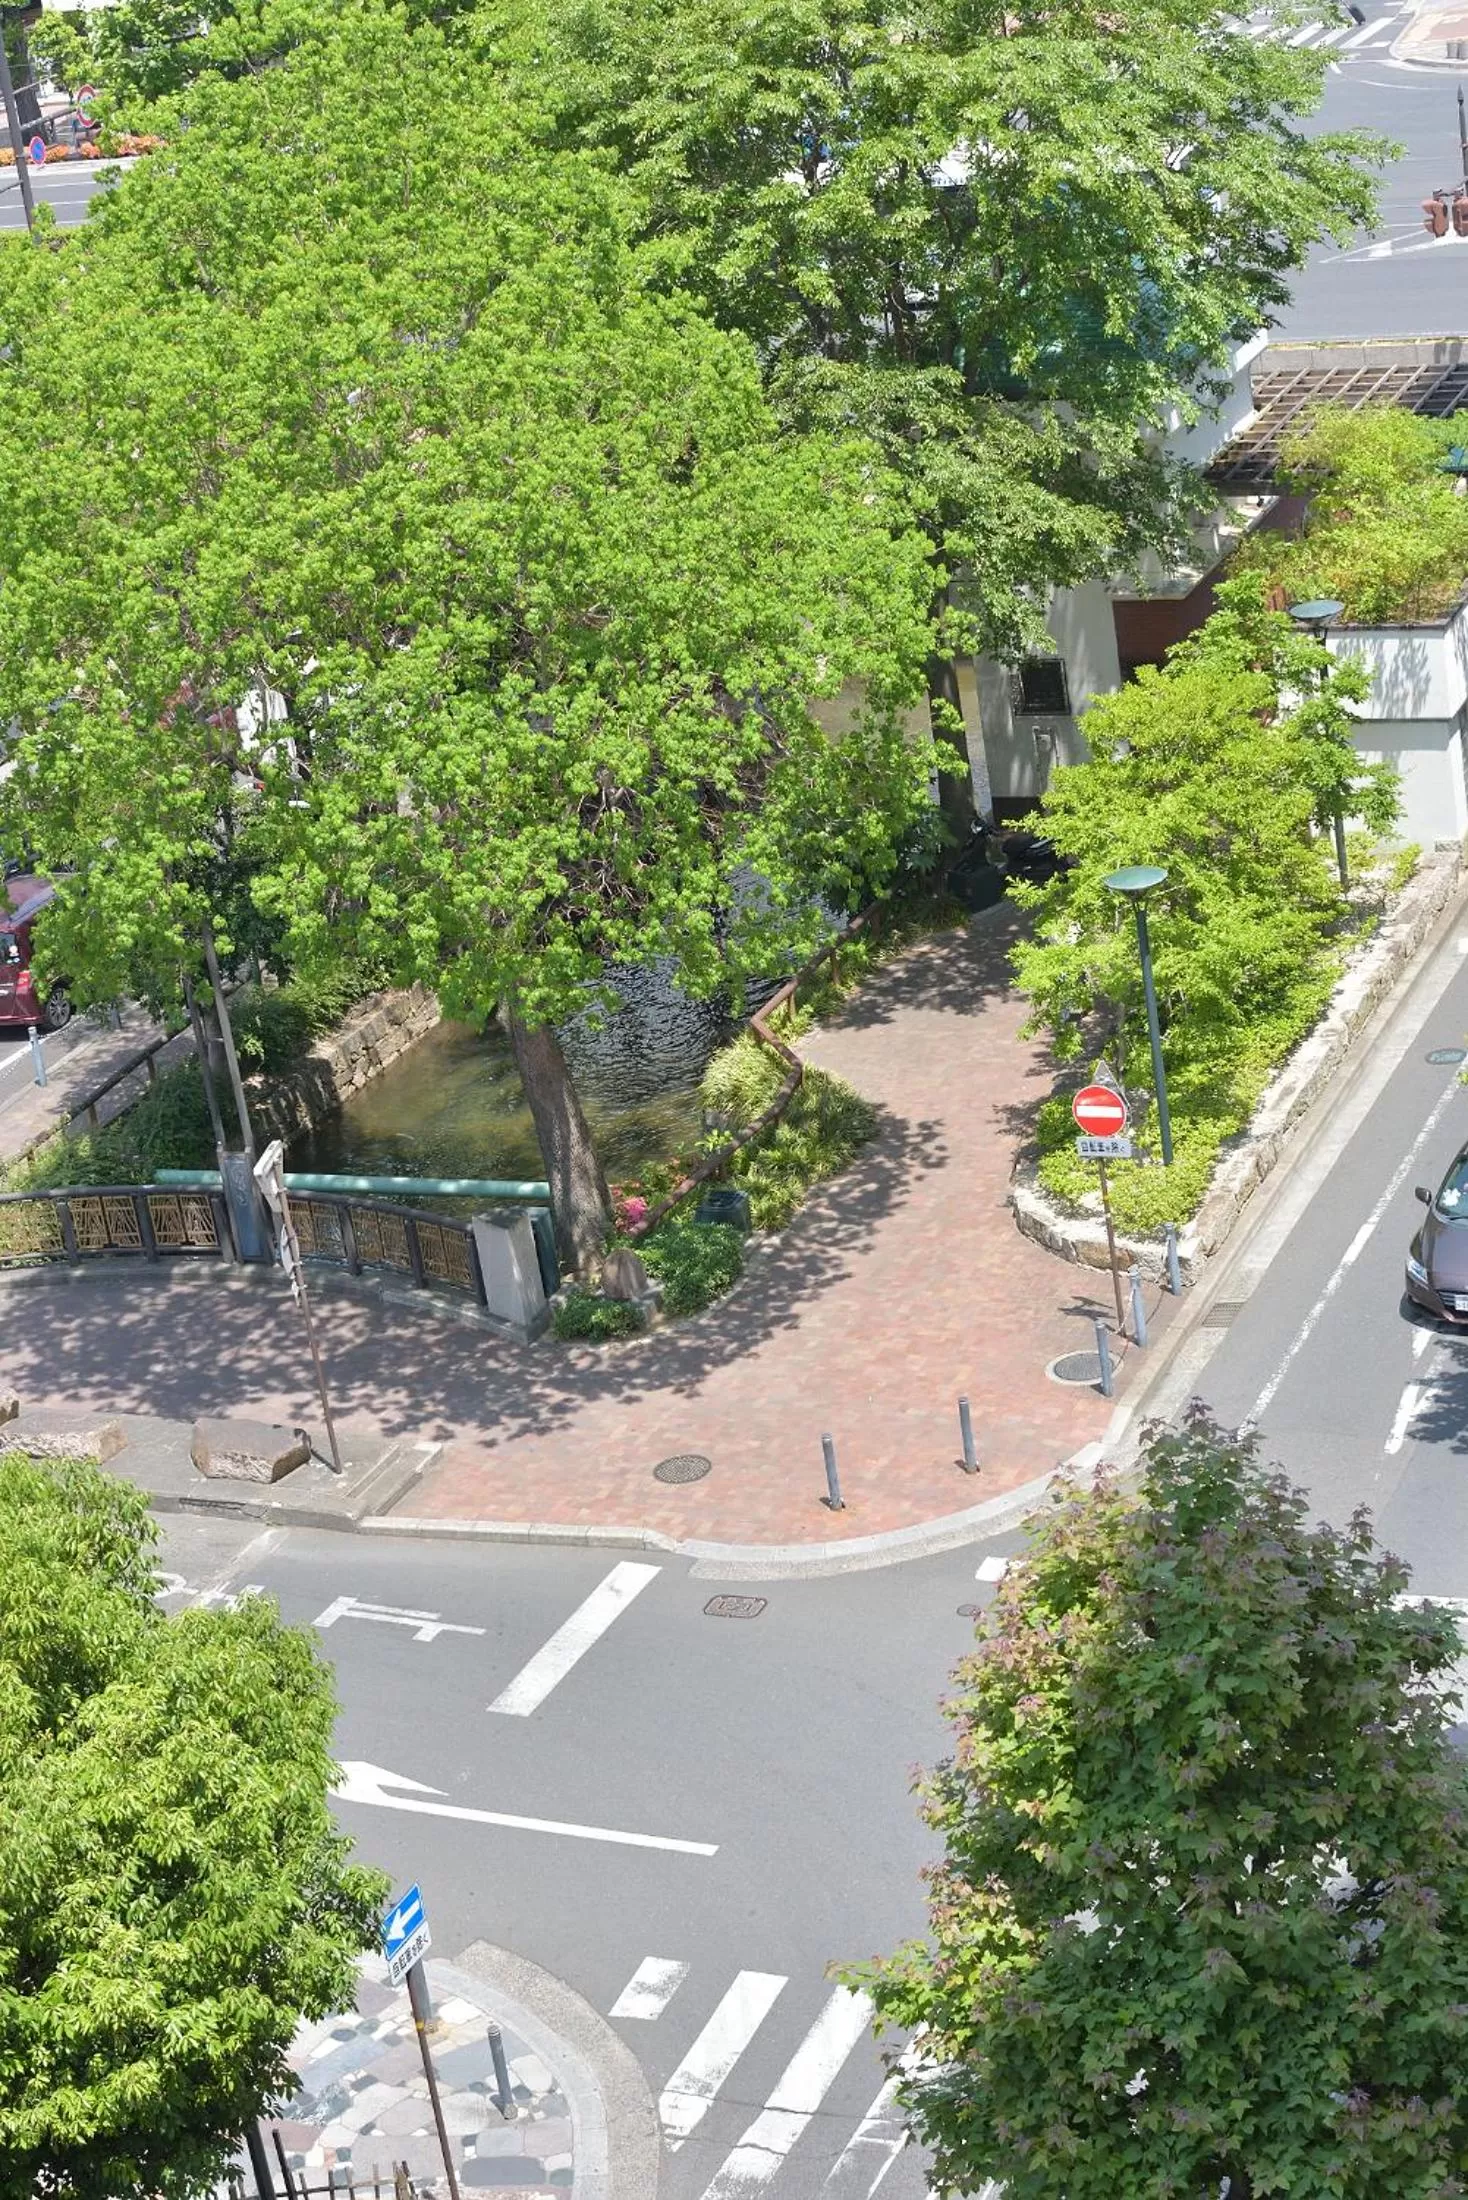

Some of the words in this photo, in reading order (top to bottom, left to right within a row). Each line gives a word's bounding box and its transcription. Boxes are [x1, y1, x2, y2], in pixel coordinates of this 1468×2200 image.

[392, 1932, 430, 1979] 自転車を除く
